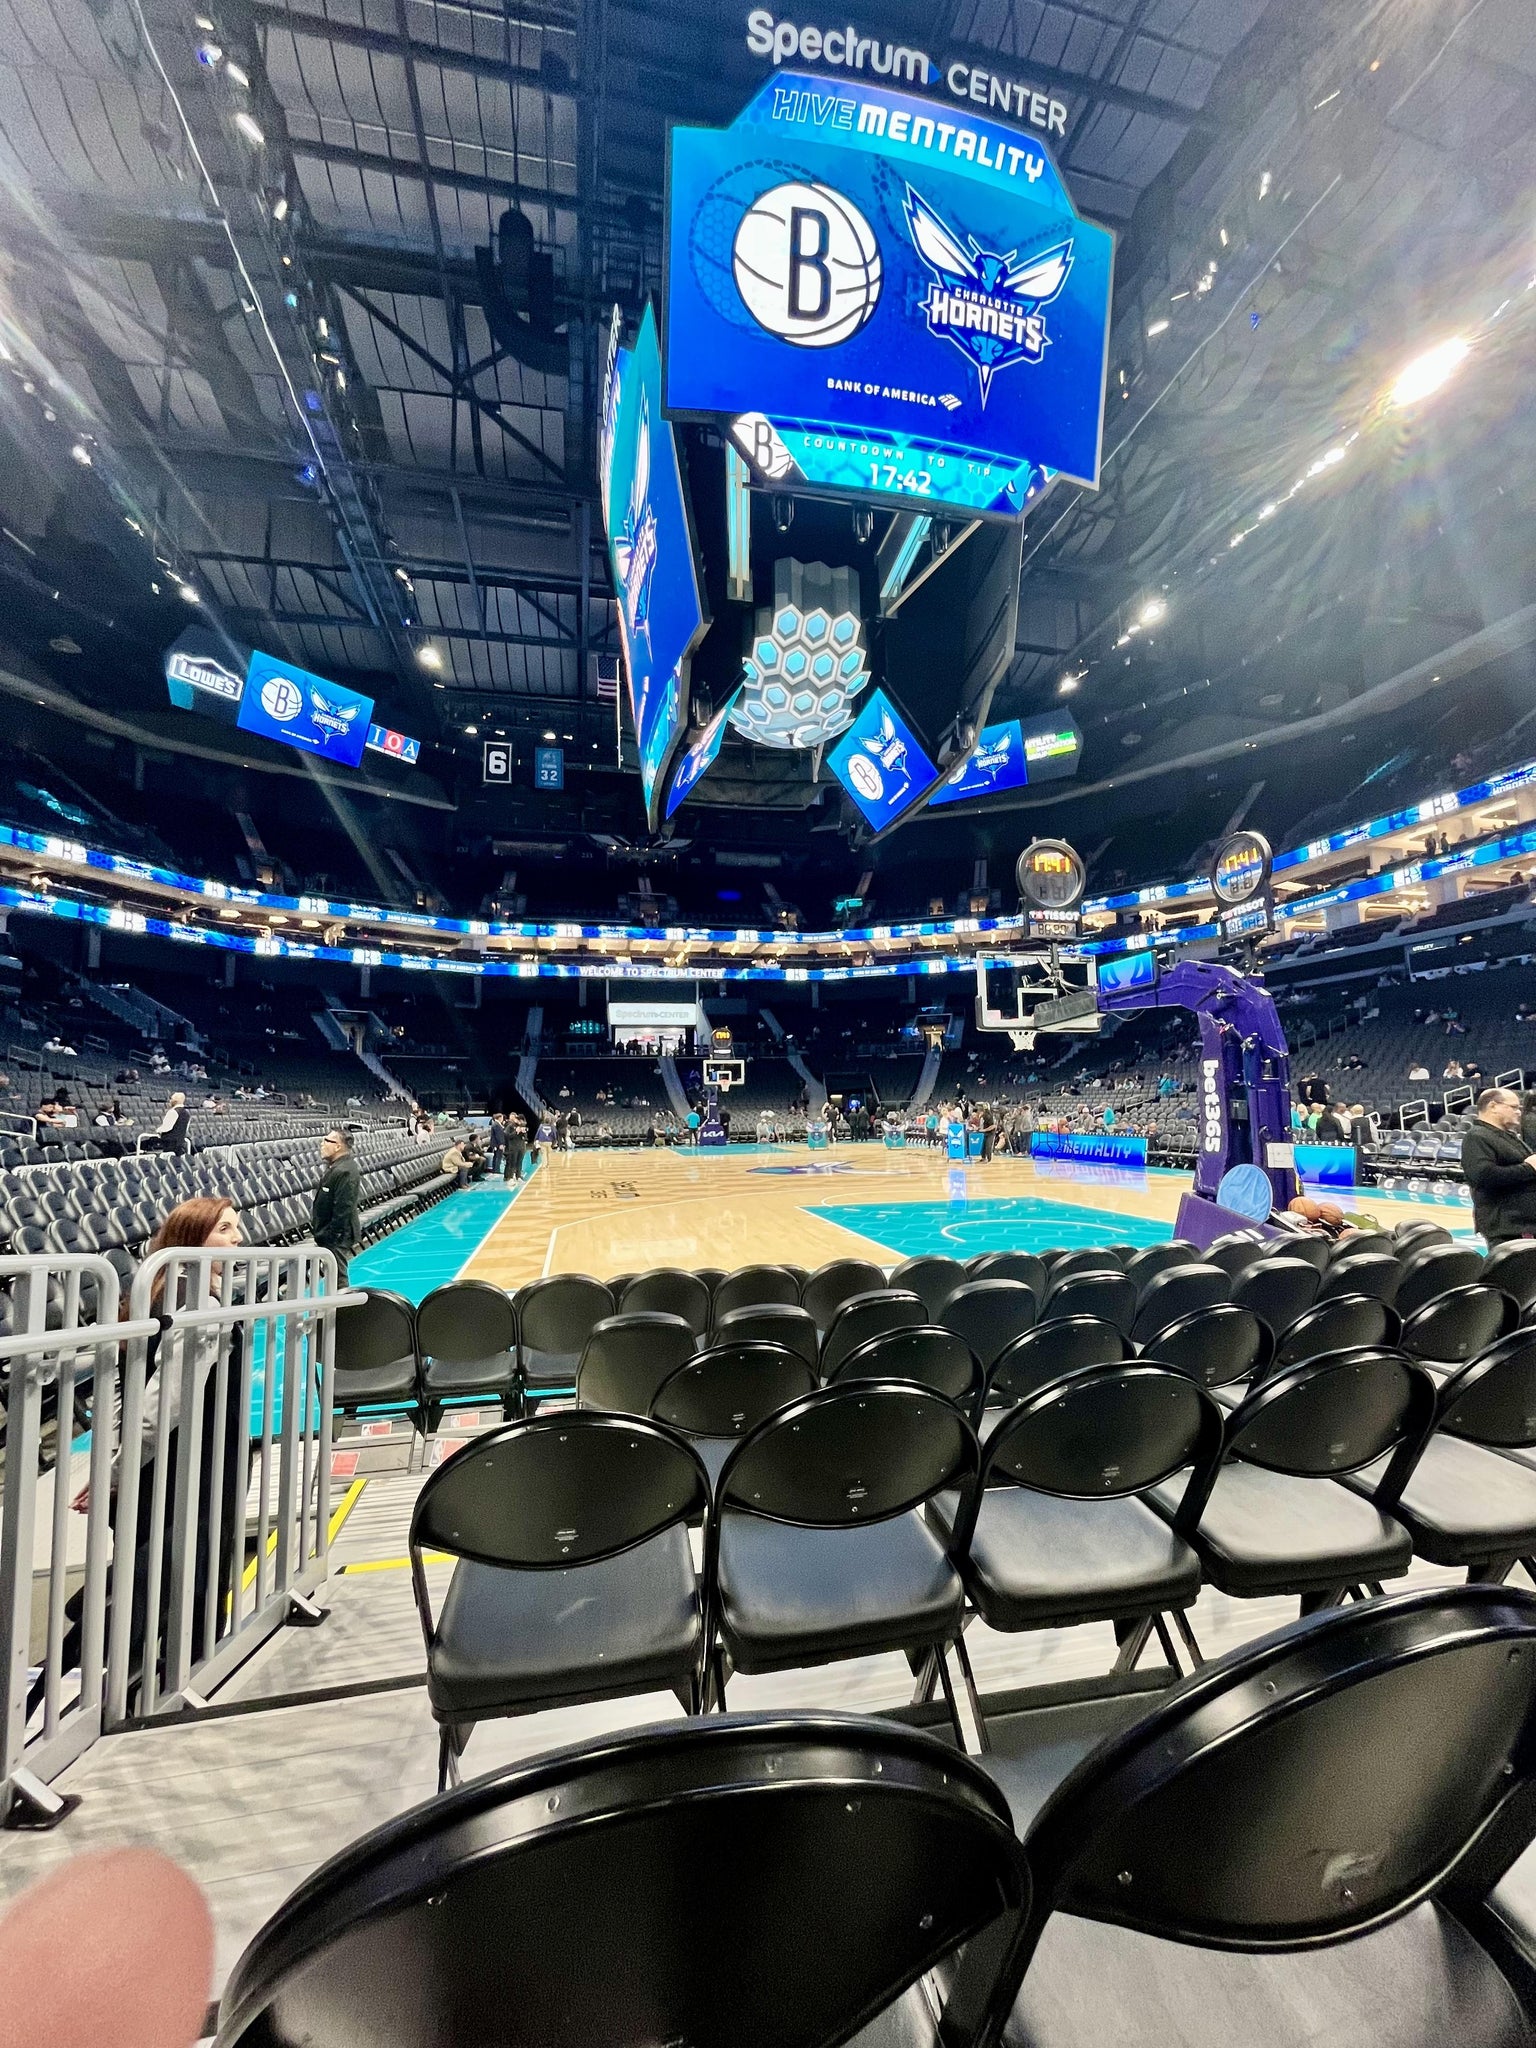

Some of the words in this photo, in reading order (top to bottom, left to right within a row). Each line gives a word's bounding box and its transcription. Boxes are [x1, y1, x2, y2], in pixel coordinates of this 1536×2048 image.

[747, 10, 930, 85] Spectrum
[948, 63, 1068, 136] CENTER
[772, 89, 856, 131] HIVE
[857, 103, 1045, 183] MENTALITY
[788, 206, 831, 322] B
[954, 287, 1024, 317] CHARLOTTE
[929, 289, 1044, 354] HORNETS
[827, 378, 862, 394] BANK
[864, 383, 880, 397] OF
[882, 386, 937, 408] AMERICA
[754, 421, 773, 469] B
[803, 435, 904, 460] COUNTDOWN
[927, 455, 946, 468] TO
[967, 463, 991, 477] TIP
[869, 462, 932, 495] 17:42
[179, 661, 236, 695] LOWE'S
[274, 684, 290, 714] B
[313, 713, 348, 732] HORNETS
[489, 751, 507, 775] 6
[541, 770, 558, 781] 32
[1034, 855, 1071, 873] 17:41
[1045, 910, 1080, 921] TISSOT
[1232, 897, 1266, 917] TISSOT
[580, 968, 624, 978] WELCOME
[626, 969, 639, 978] TO
[641, 969, 688, 978] SPECTRUM
[690, 969, 723, 979] CENTER
[659, 1010, 689, 1018] CENTER
[1203, 1059, 1222, 1153] bet365
[1063, 1140, 1132, 1159] MENTALITY
[1407, 1180, 1420, 1192] G
